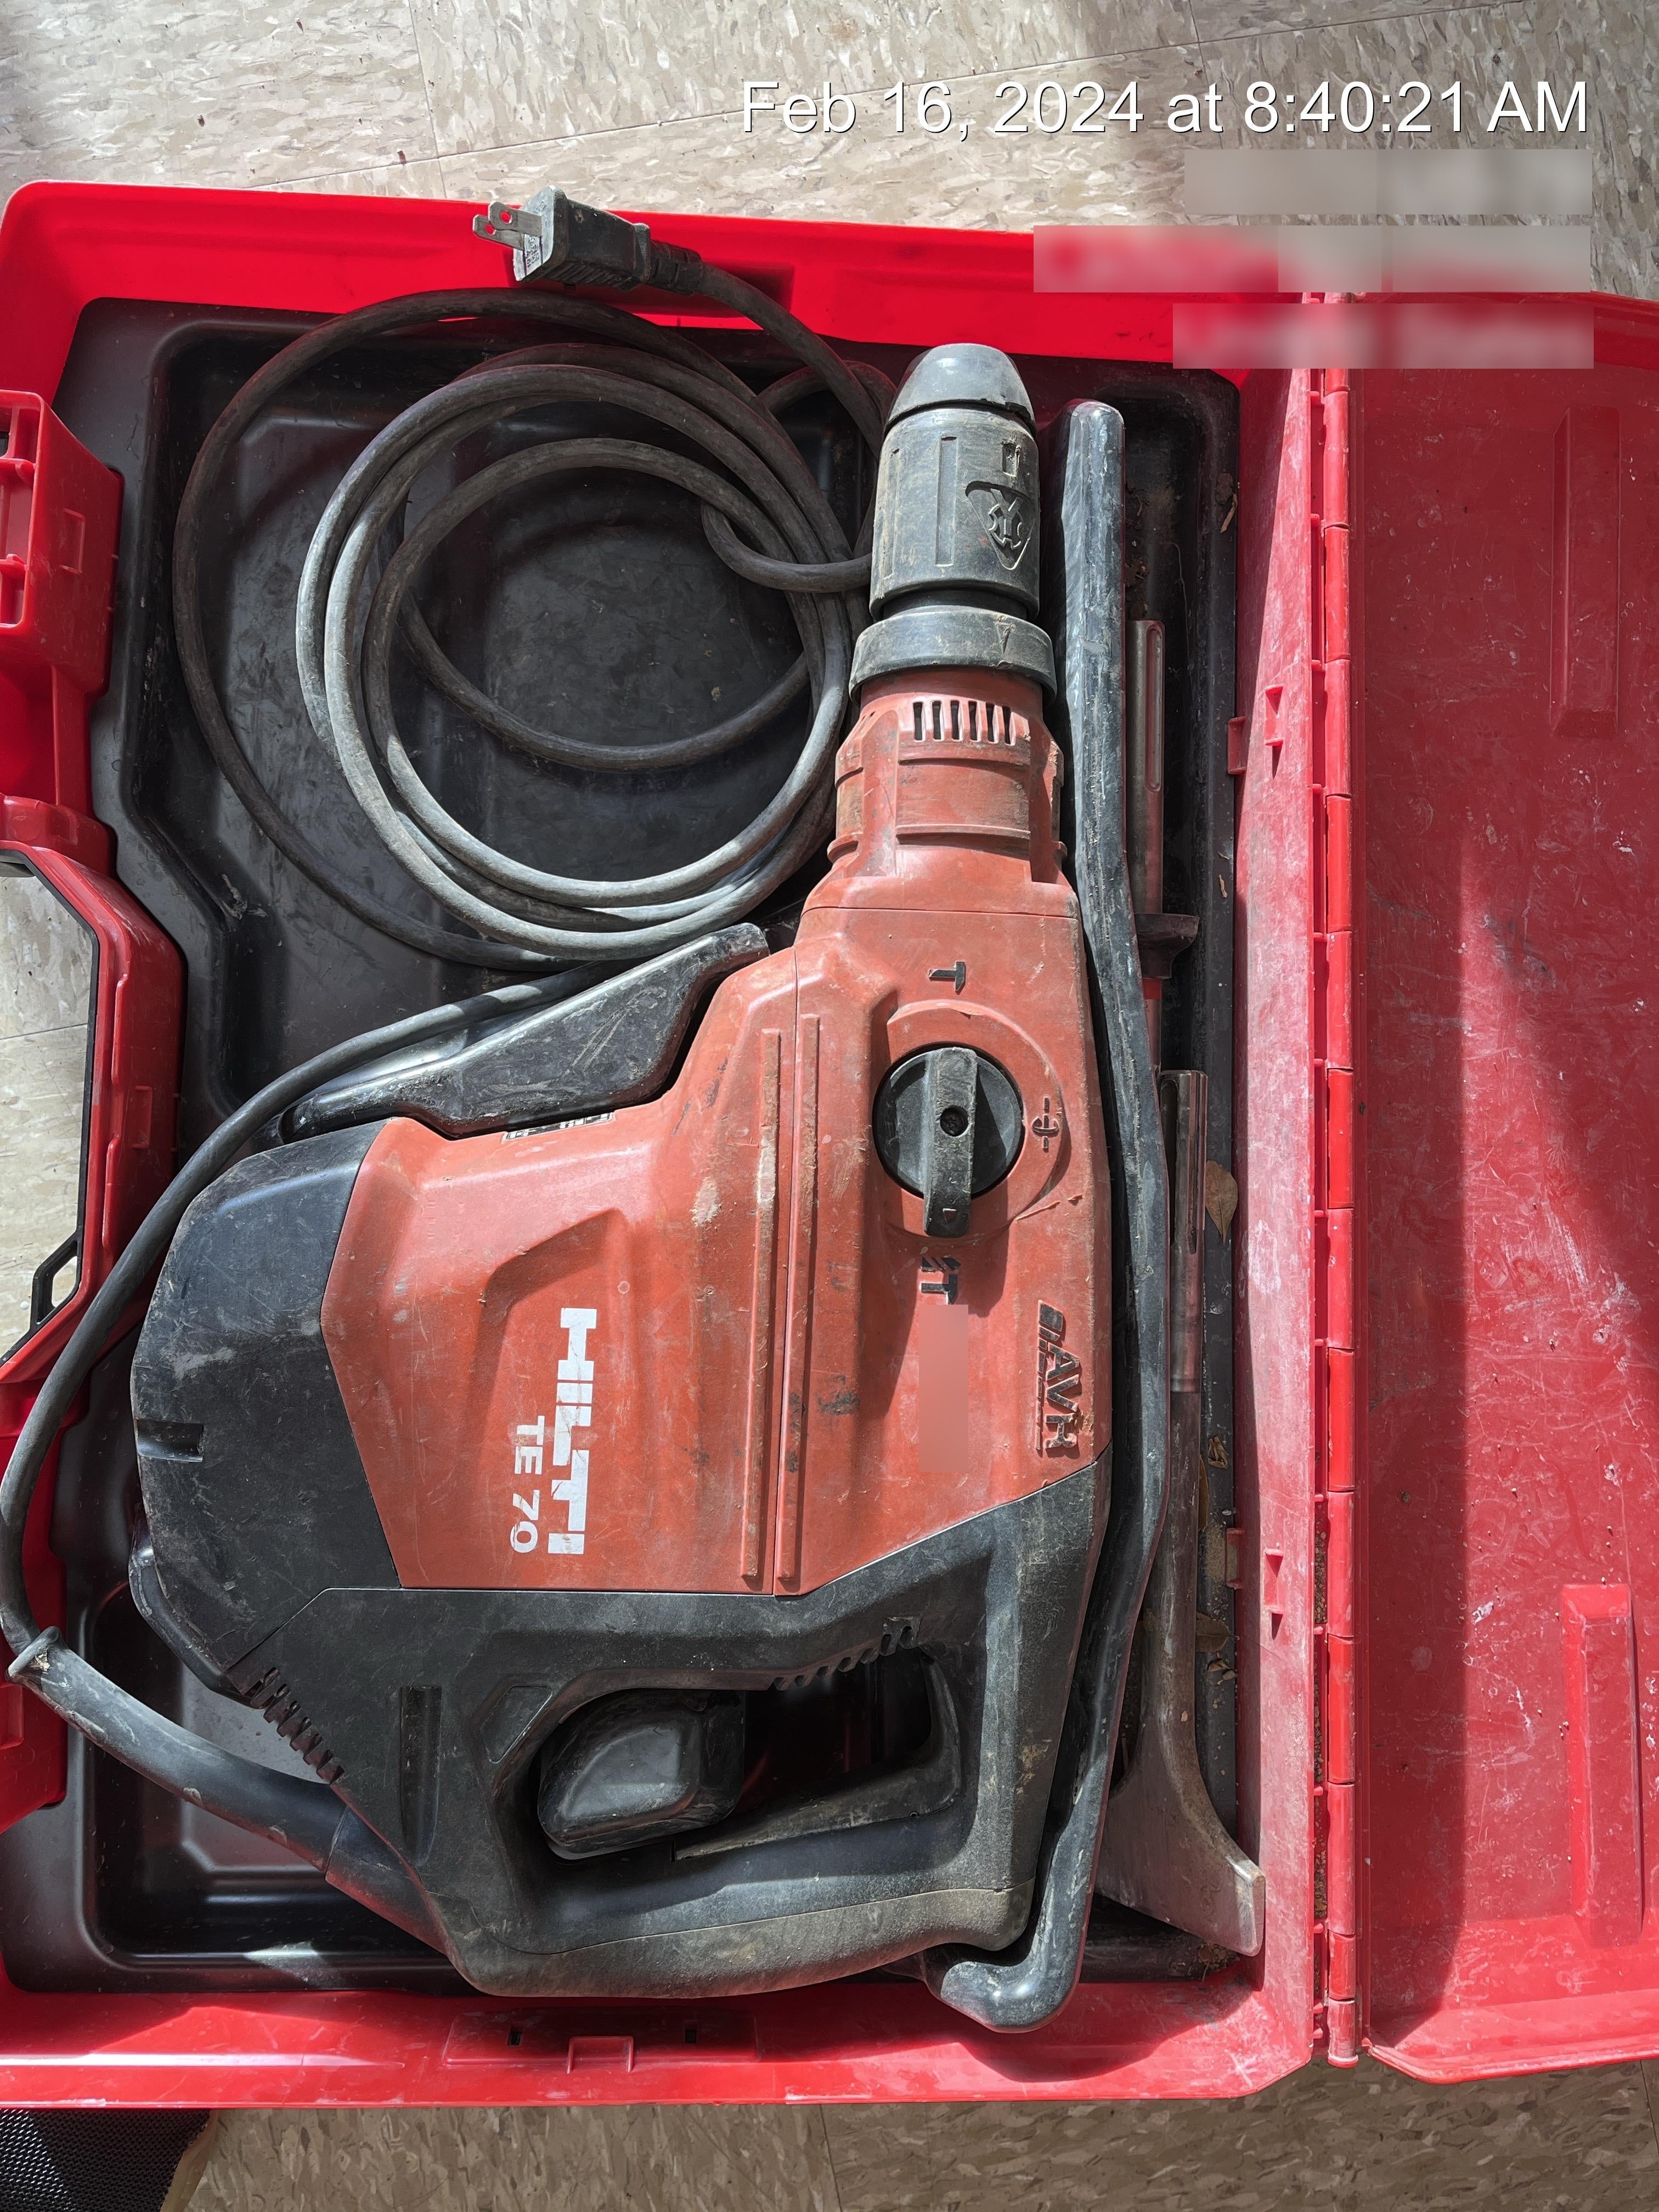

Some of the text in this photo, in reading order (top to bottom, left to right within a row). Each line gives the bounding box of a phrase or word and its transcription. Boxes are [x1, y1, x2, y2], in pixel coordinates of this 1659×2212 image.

[548, 1307, 597, 1555] HILTI
[1045, 1341, 1080, 1449] AVR
[510, 1415, 545, 1554] TE 70
